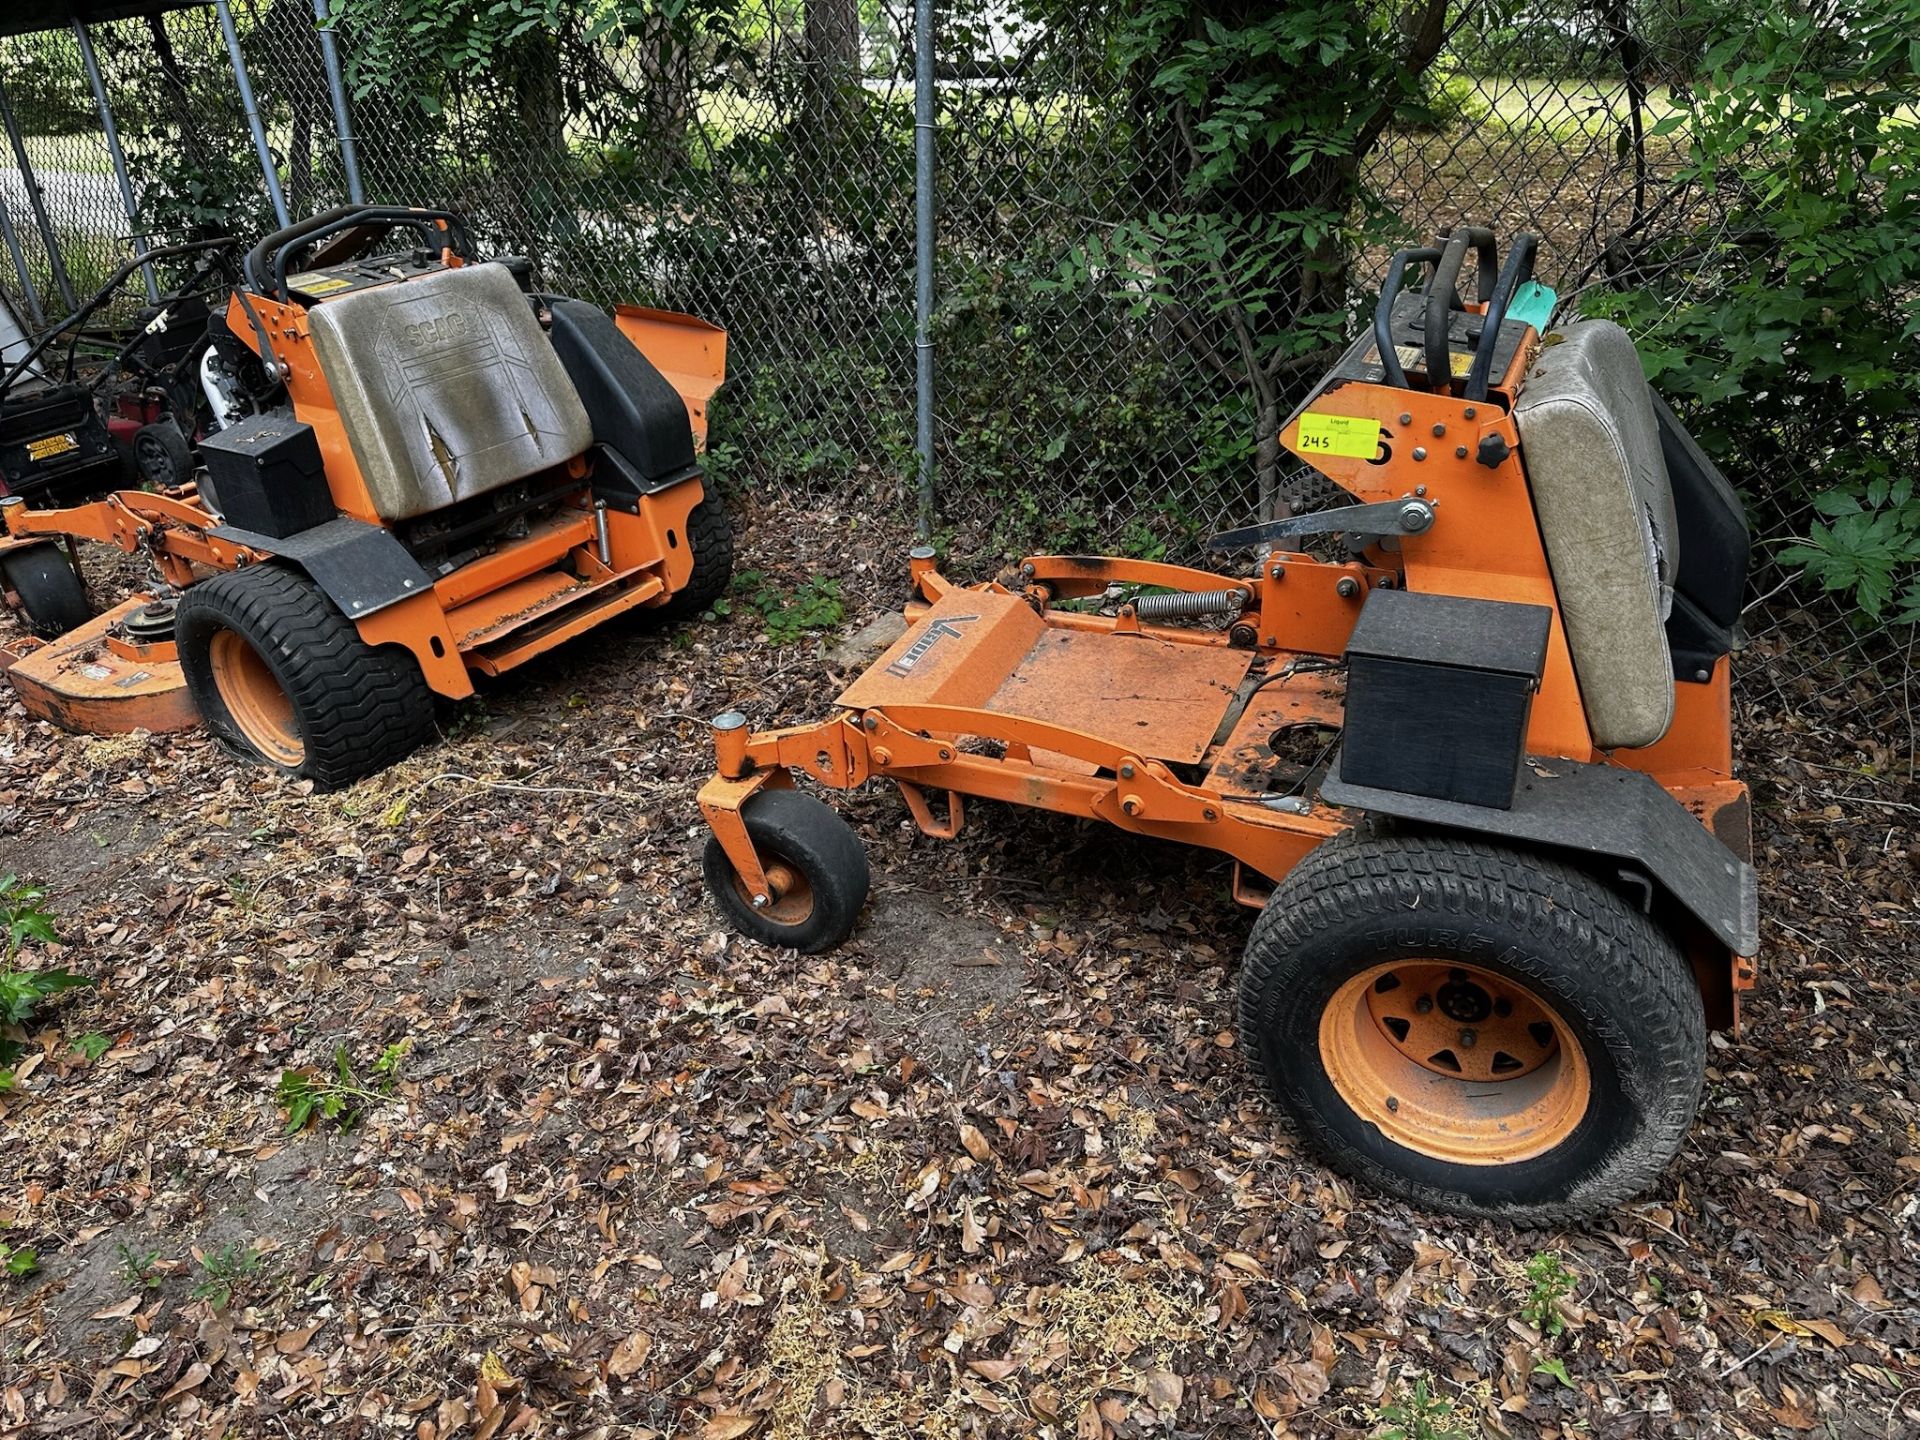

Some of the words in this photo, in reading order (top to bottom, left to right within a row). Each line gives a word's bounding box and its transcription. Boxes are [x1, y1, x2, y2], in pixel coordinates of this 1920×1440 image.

[404, 313, 467, 347] SCAG
[1302, 435, 1329, 448] 245
[1366, 927, 1495, 953] TURF
